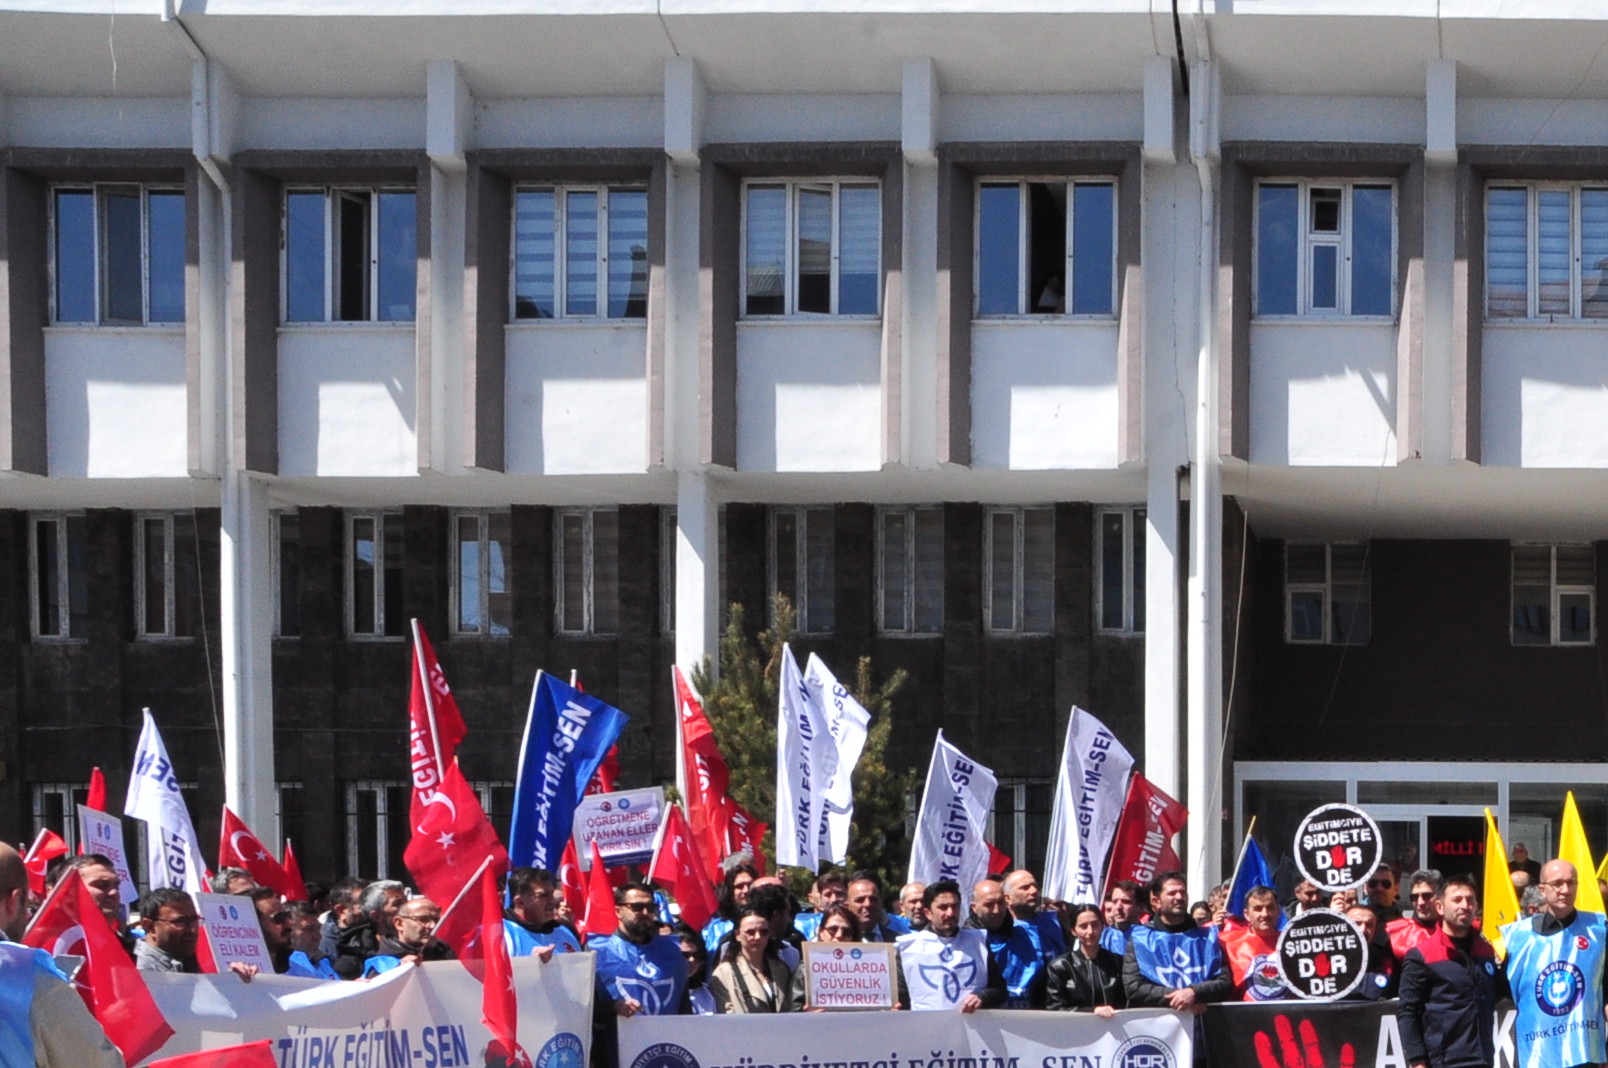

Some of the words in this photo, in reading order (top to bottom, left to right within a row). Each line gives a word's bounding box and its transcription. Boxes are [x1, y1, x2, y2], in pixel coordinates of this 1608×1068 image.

[627, 823, 658, 836] ELLER
[1326, 867, 1353, 885] DE
[812, 962, 887, 974] OKULLARDA
[820, 975, 881, 989] GÜVENLİK
[1310, 977, 1337, 994] DE
[816, 991, 879, 1004] İSTİYORUZ
